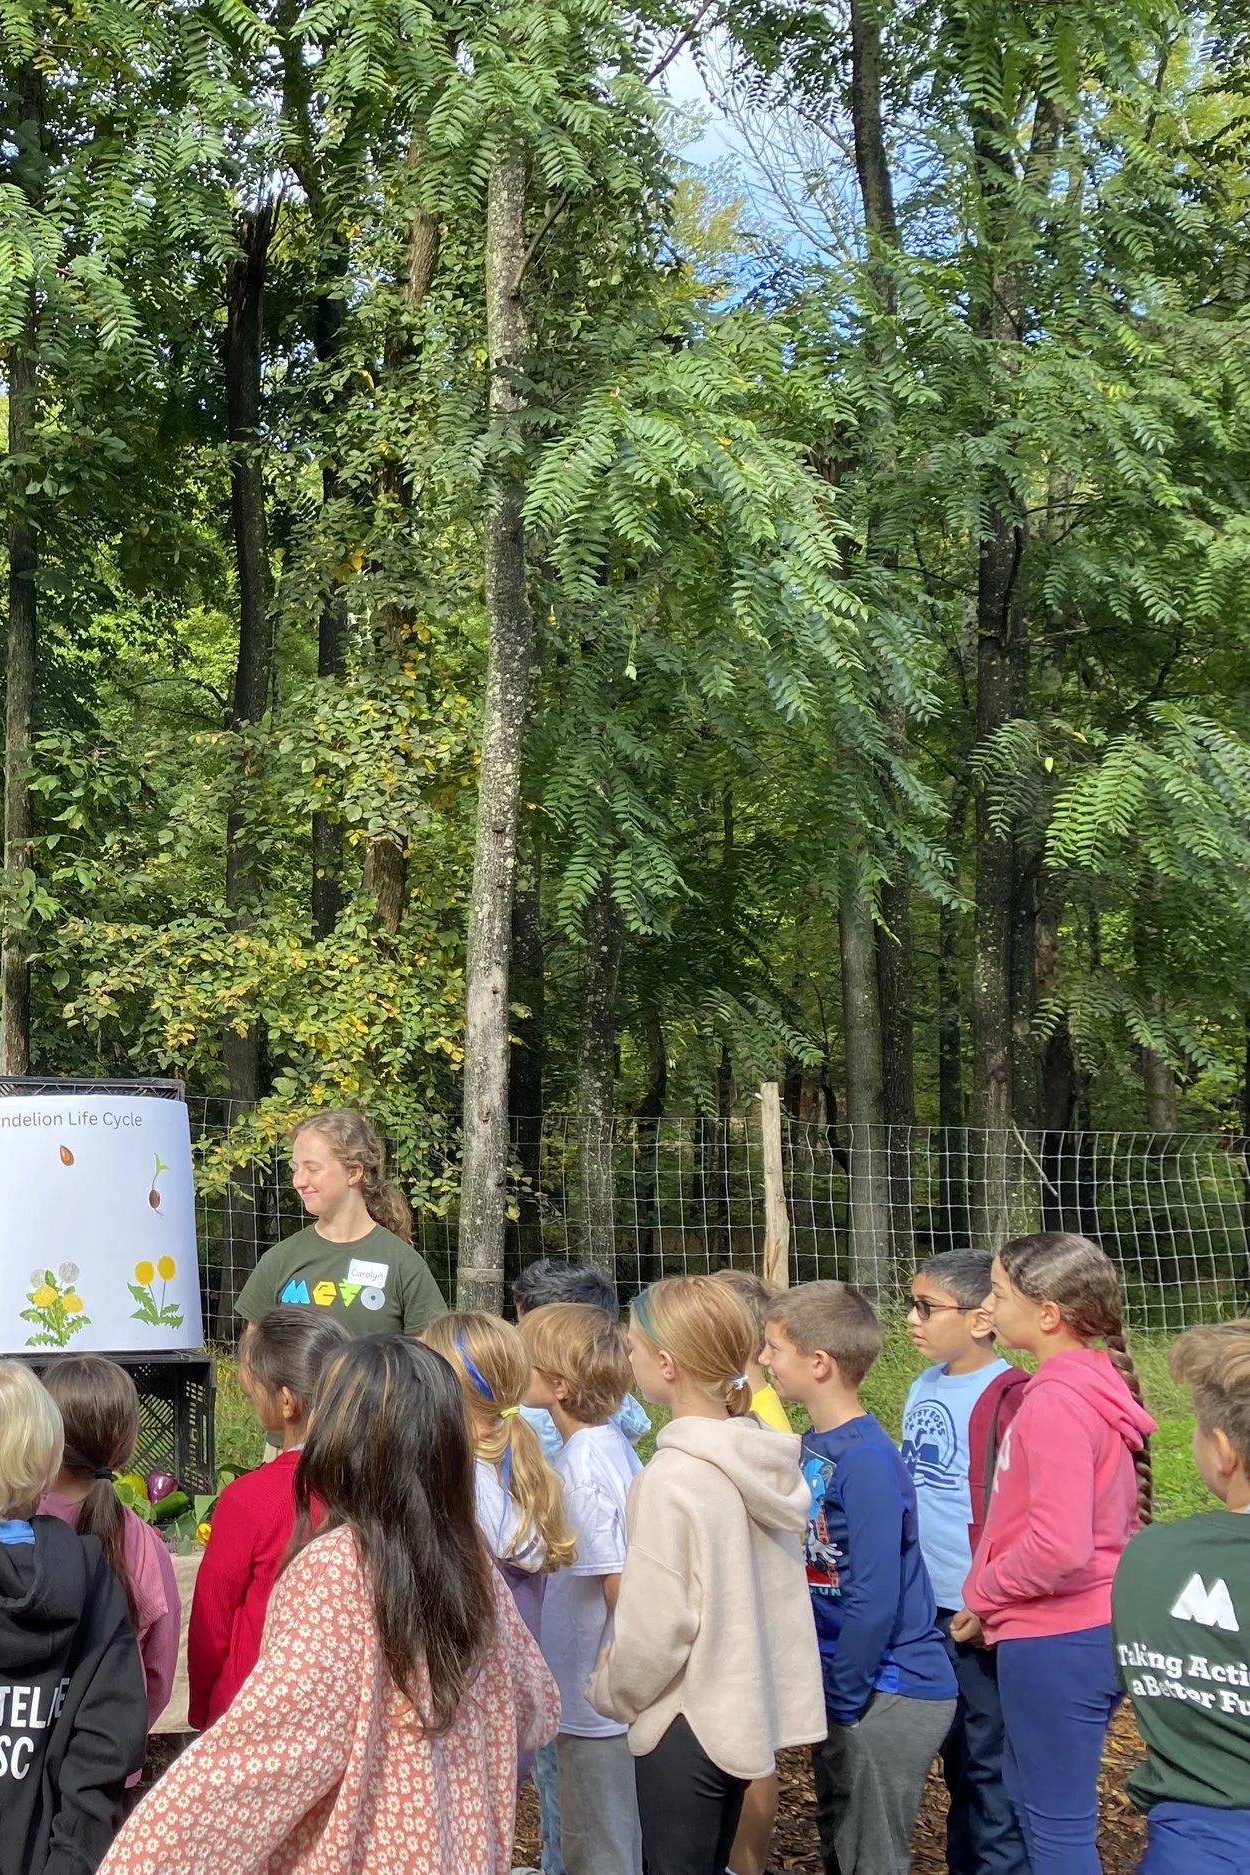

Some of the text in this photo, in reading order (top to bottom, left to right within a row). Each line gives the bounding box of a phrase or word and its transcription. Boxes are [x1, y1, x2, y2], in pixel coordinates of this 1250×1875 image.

[68, 1111, 98, 1126] Life
[102, 1111, 143, 1130] Cycle
[350, 1268, 384, 1281] Carolyn
[1117, 1642, 1250, 1687] Taking Acti
[1218, 1689, 1250, 1717] Fu
